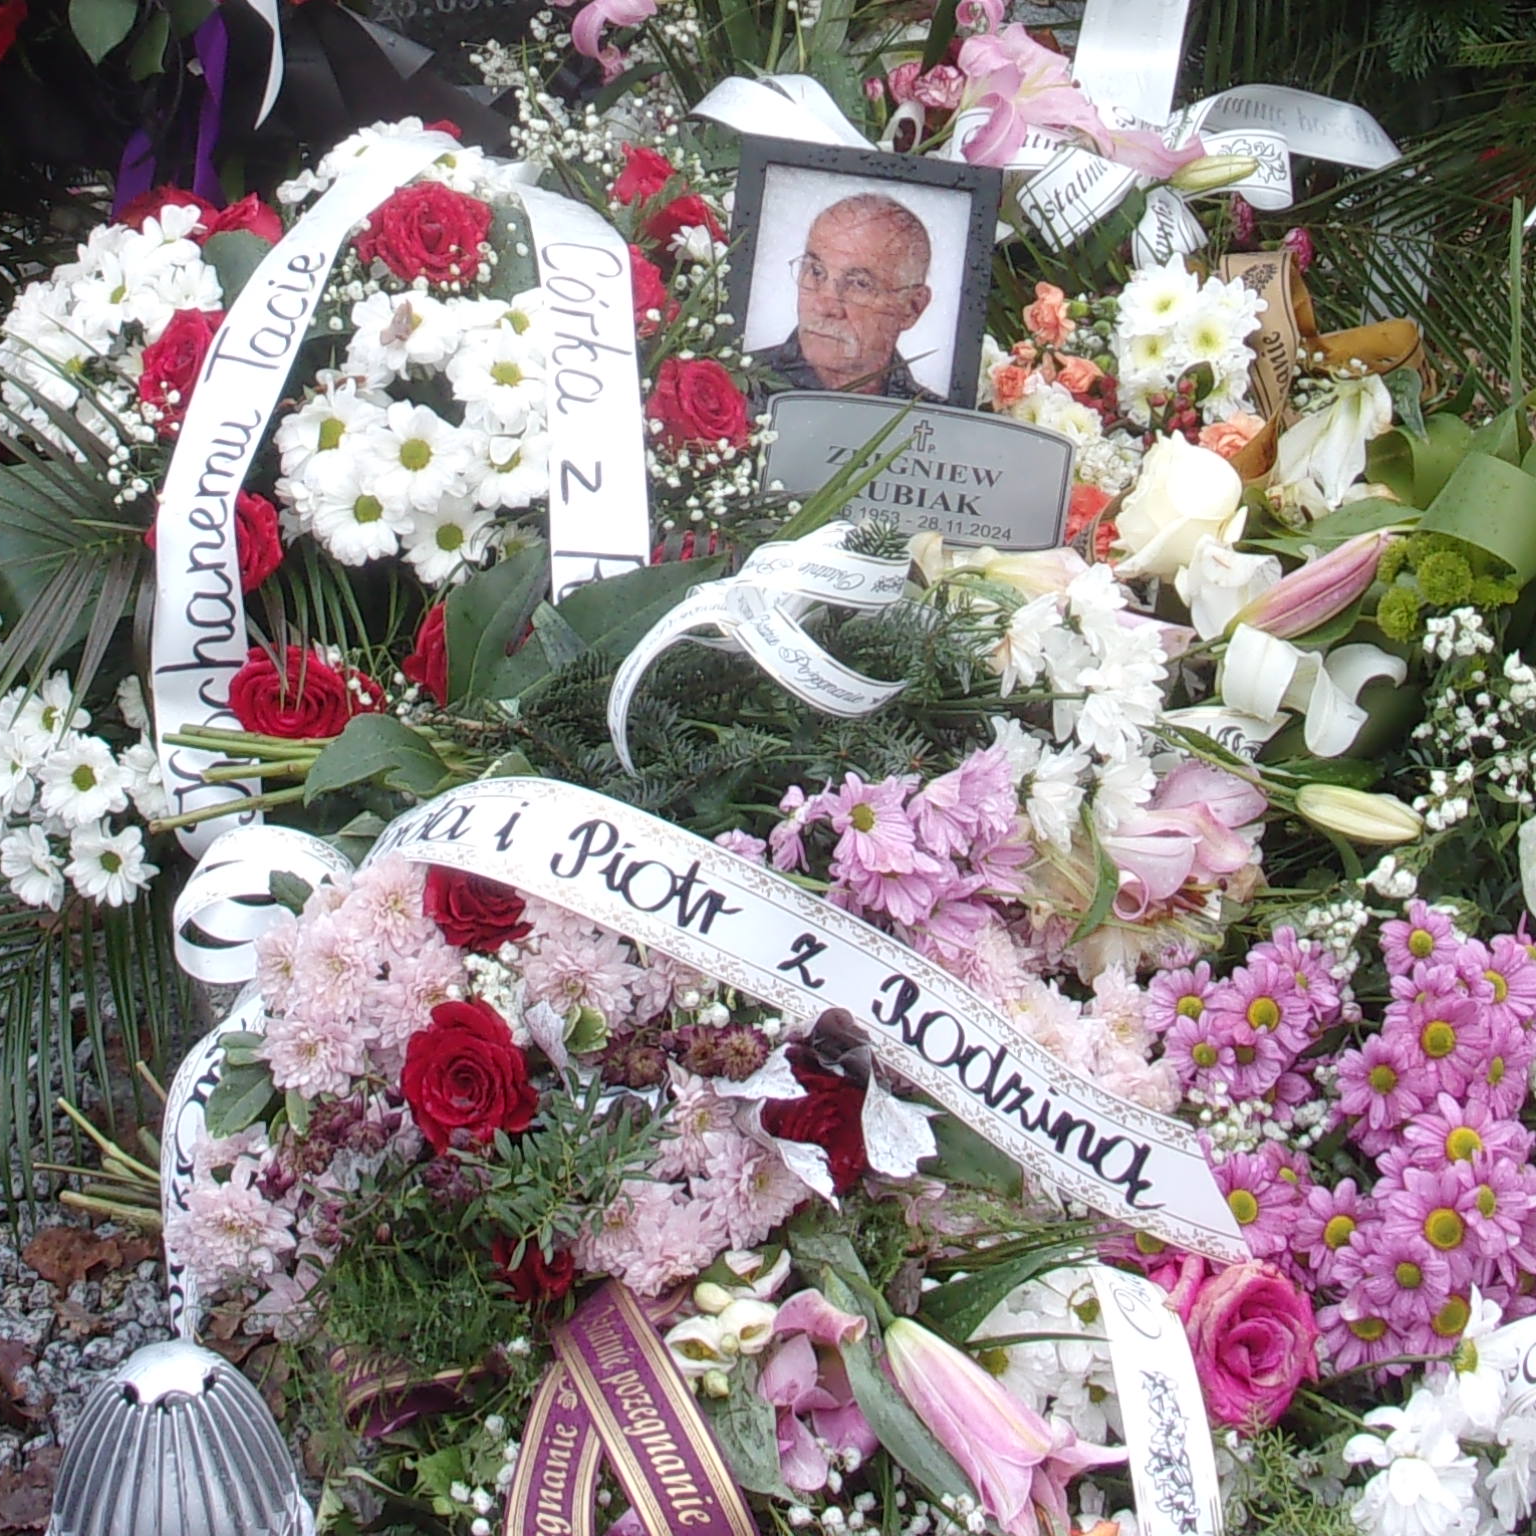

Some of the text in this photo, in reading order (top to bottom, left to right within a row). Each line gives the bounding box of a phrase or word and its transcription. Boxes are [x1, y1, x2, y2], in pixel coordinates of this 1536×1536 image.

[204, 250, 325, 387] Tacie
[560, 460, 603, 506] z
[850, 480, 983, 517] UBIAK
[918, 514, 1013, 543] 28.11.2024
[550, 816, 742, 942] Piotr
